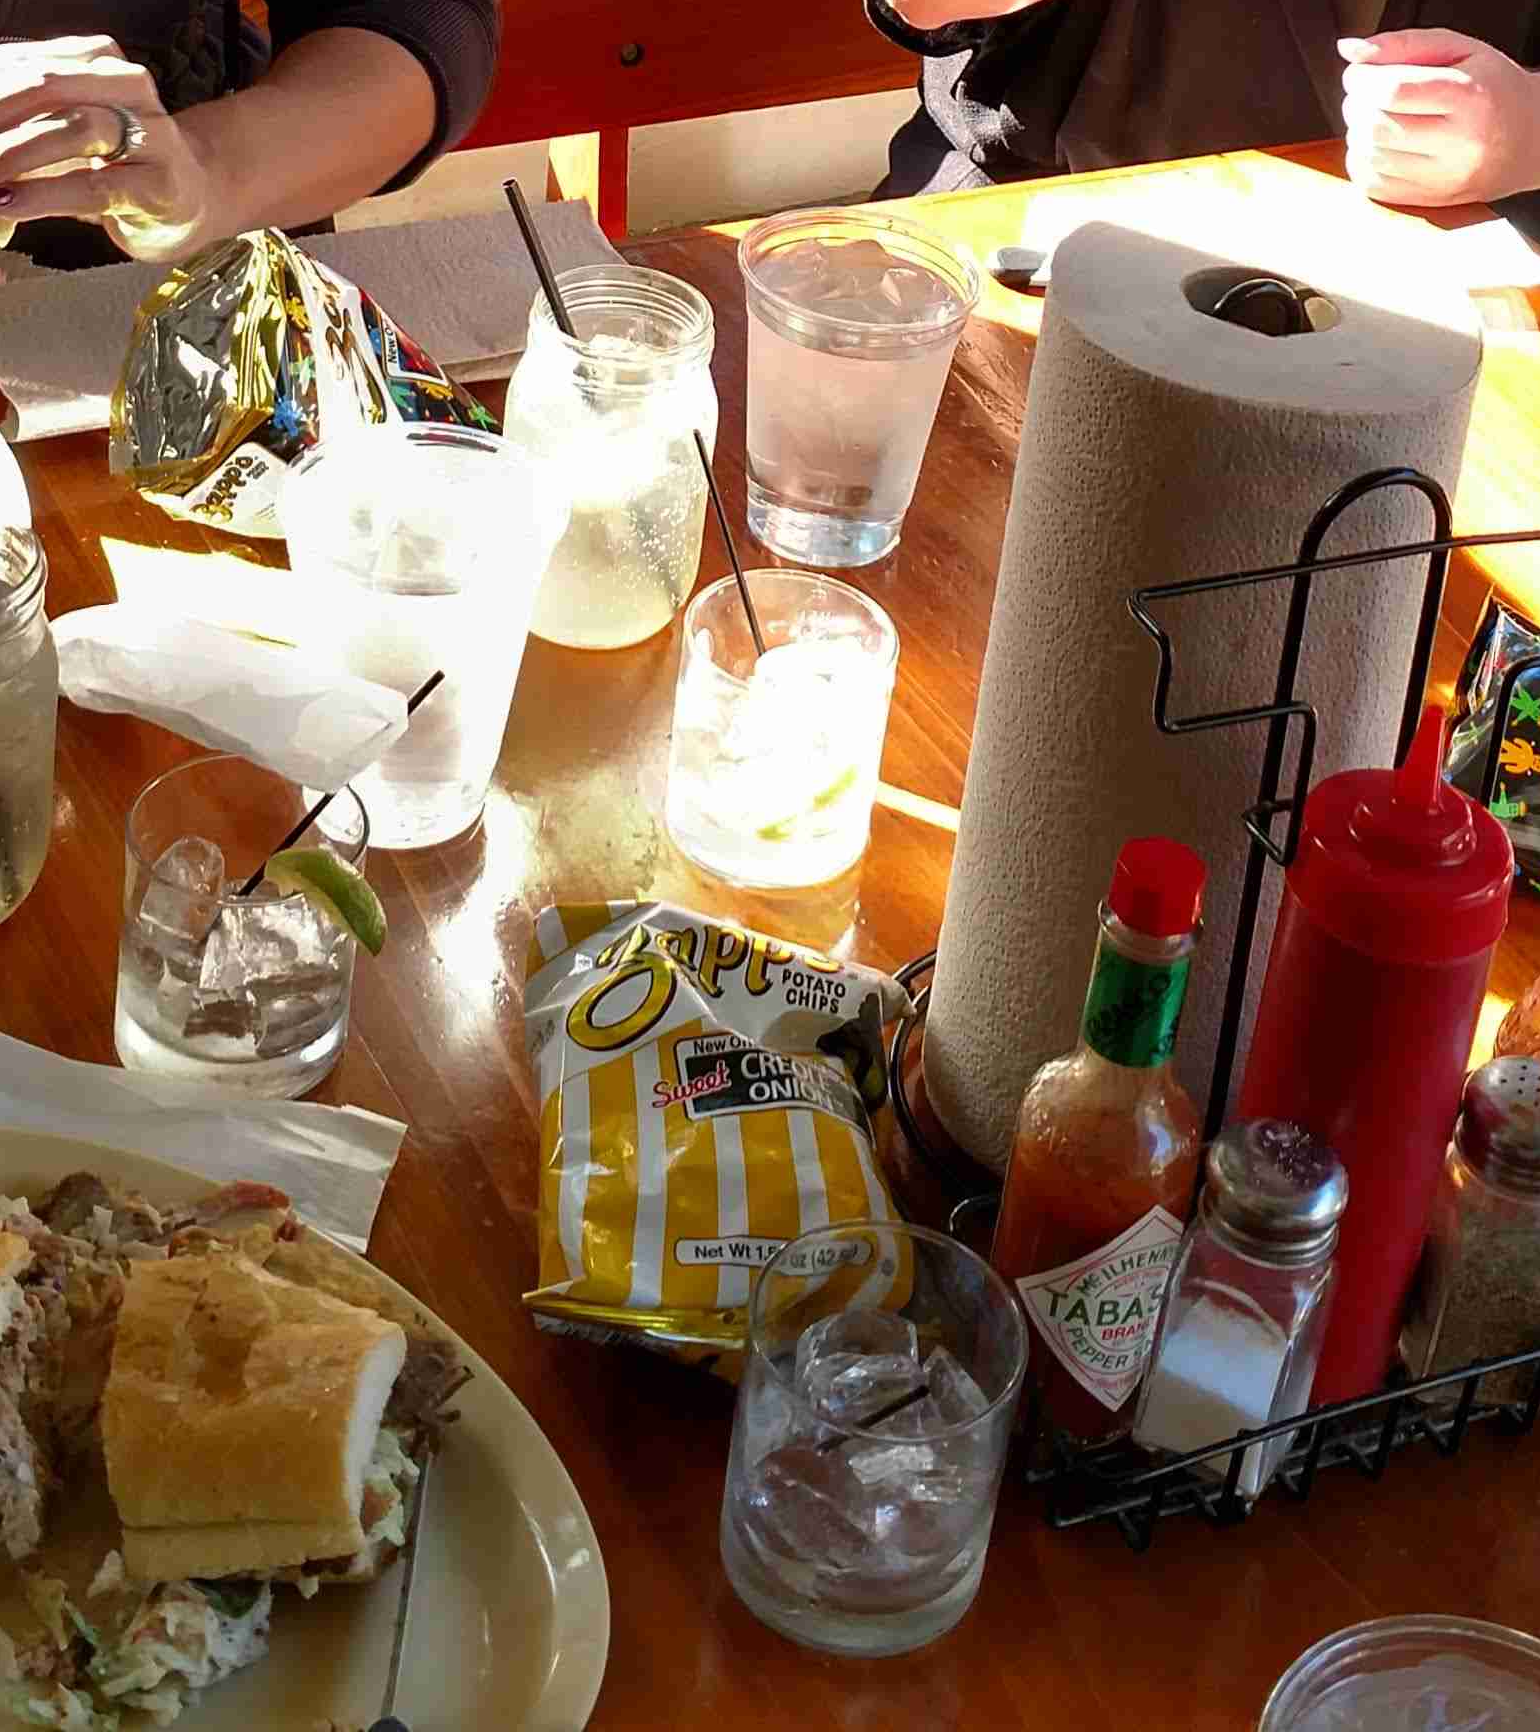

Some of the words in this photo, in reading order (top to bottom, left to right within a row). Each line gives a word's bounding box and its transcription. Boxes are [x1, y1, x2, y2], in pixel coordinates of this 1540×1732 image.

[387, 340, 398, 365] New
[781, 969, 847, 999] POTATO
[785, 988, 840, 1016] CHIPS
[693, 1039, 728, 1056] New
[652, 1060, 732, 1108] Sweet
[694, 1244, 723, 1259] Net
[728, 1243, 751, 1259] Wt
[1044, 1283, 1165, 1327] TABAS
[1067, 1326, 1129, 1369] PEPPER
